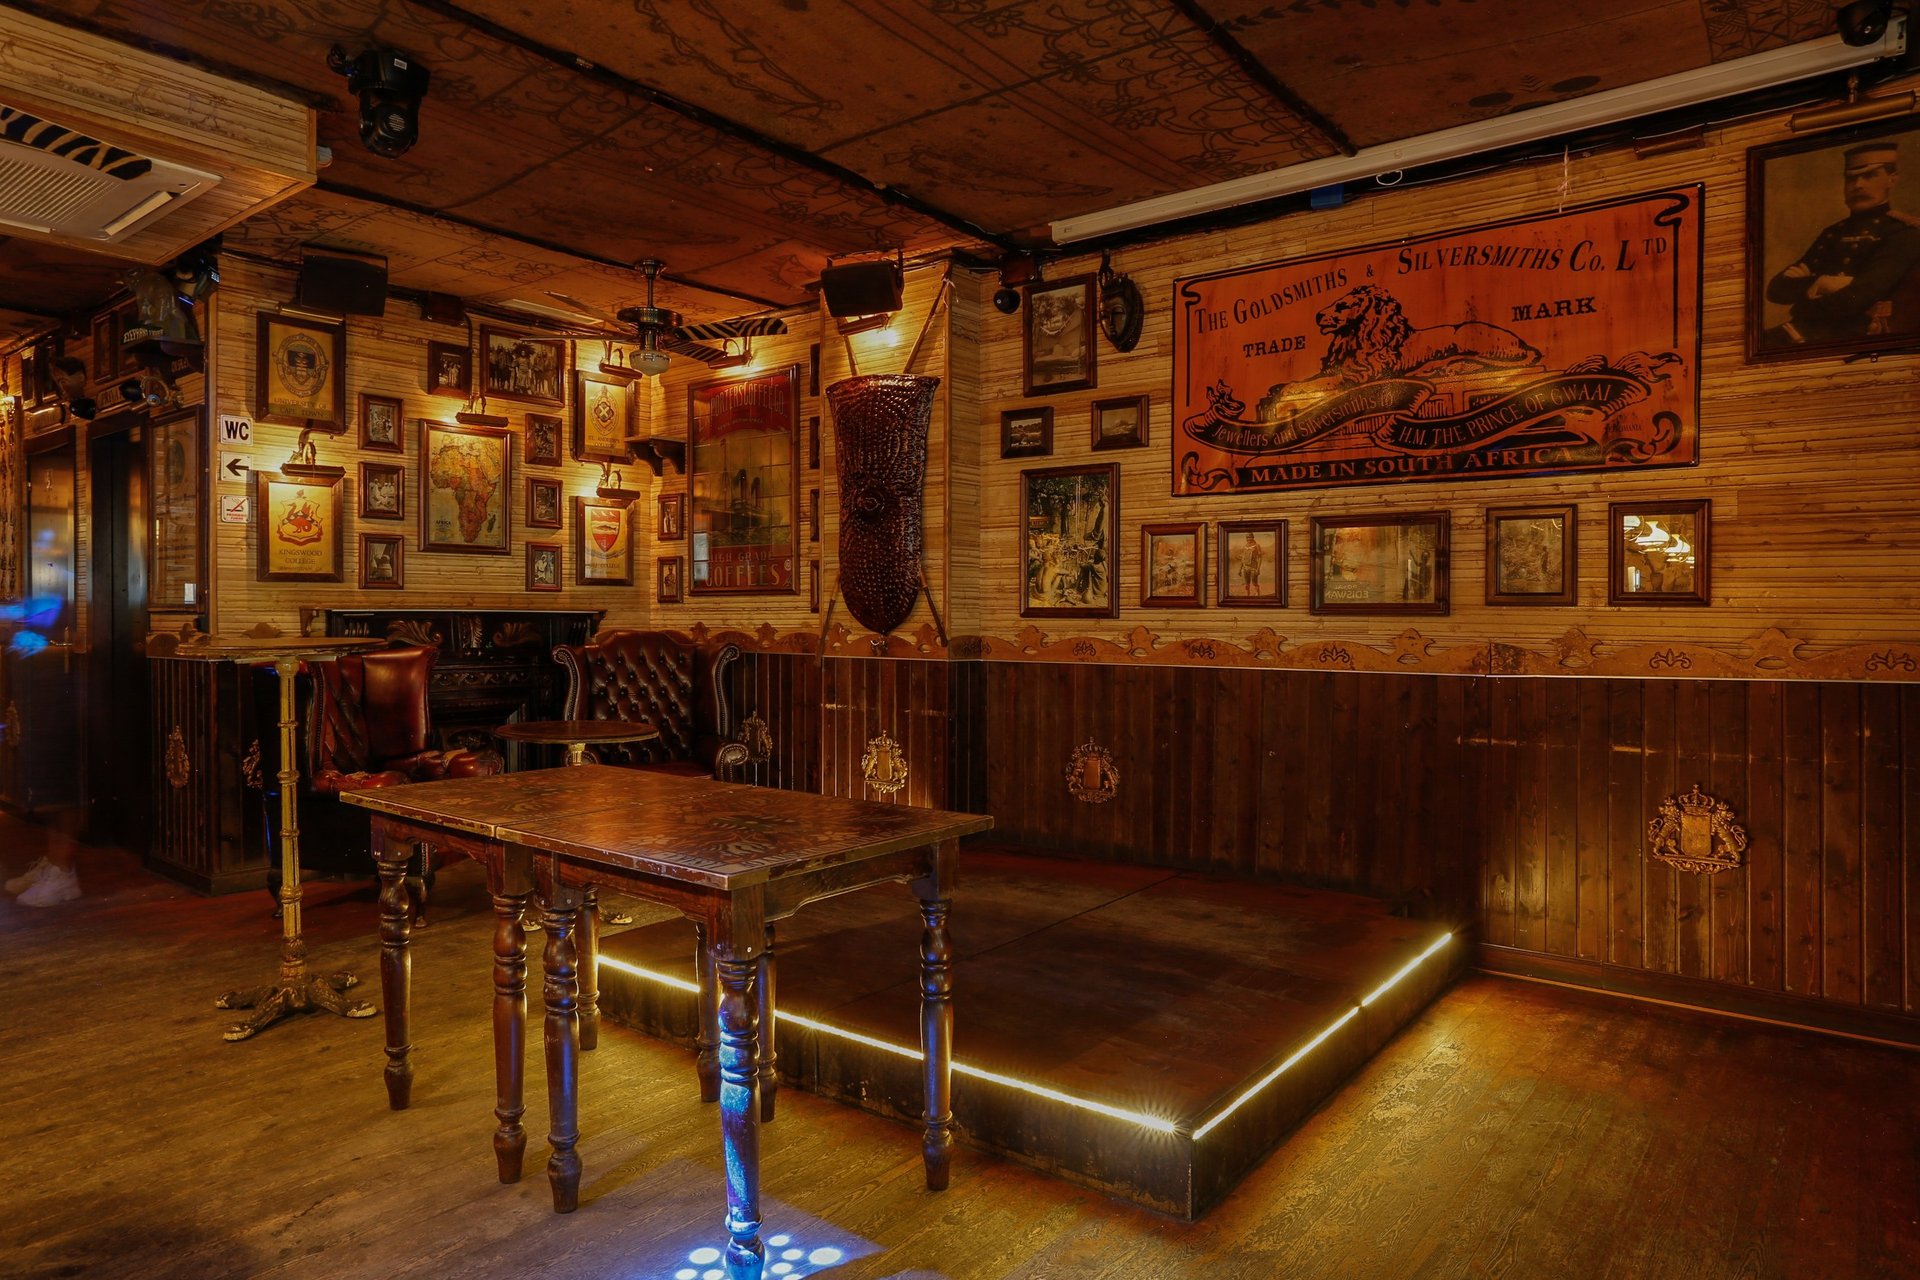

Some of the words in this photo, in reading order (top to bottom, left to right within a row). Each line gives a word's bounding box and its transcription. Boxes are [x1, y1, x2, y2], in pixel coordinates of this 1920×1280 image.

[1194, 308, 1228, 334] THE
[1233, 268, 1348, 325] GOLDSMITHS
[1366, 263, 1374, 278] &
[1397, 244, 1565, 275] SILVERSMITHS
[1243, 335, 1306, 358] TRADE
[1511, 296, 1597, 322] MARK
[744, 381, 773, 409] COFFEE
[225, 420, 249, 441] WC
[1399, 425, 1428, 447] H.M.
[1432, 425, 1466, 445] THE
[1466, 403, 1524, 439] PRINCE
[1525, 392, 1548, 415] OF
[1212, 424, 1269, 448] Jewellers
[1273, 429, 1298, 446] and
[1251, 464, 1322, 484] MADE
[1324, 461, 1356, 478] IN
[1364, 454, 1453, 477] SOUTH
[1464, 447, 1574, 469] AFRICA
[279, 548, 323, 557] KINGSWOOD
[738, 550, 775, 562] GRADE
[704, 563, 780, 587] COFFEES
